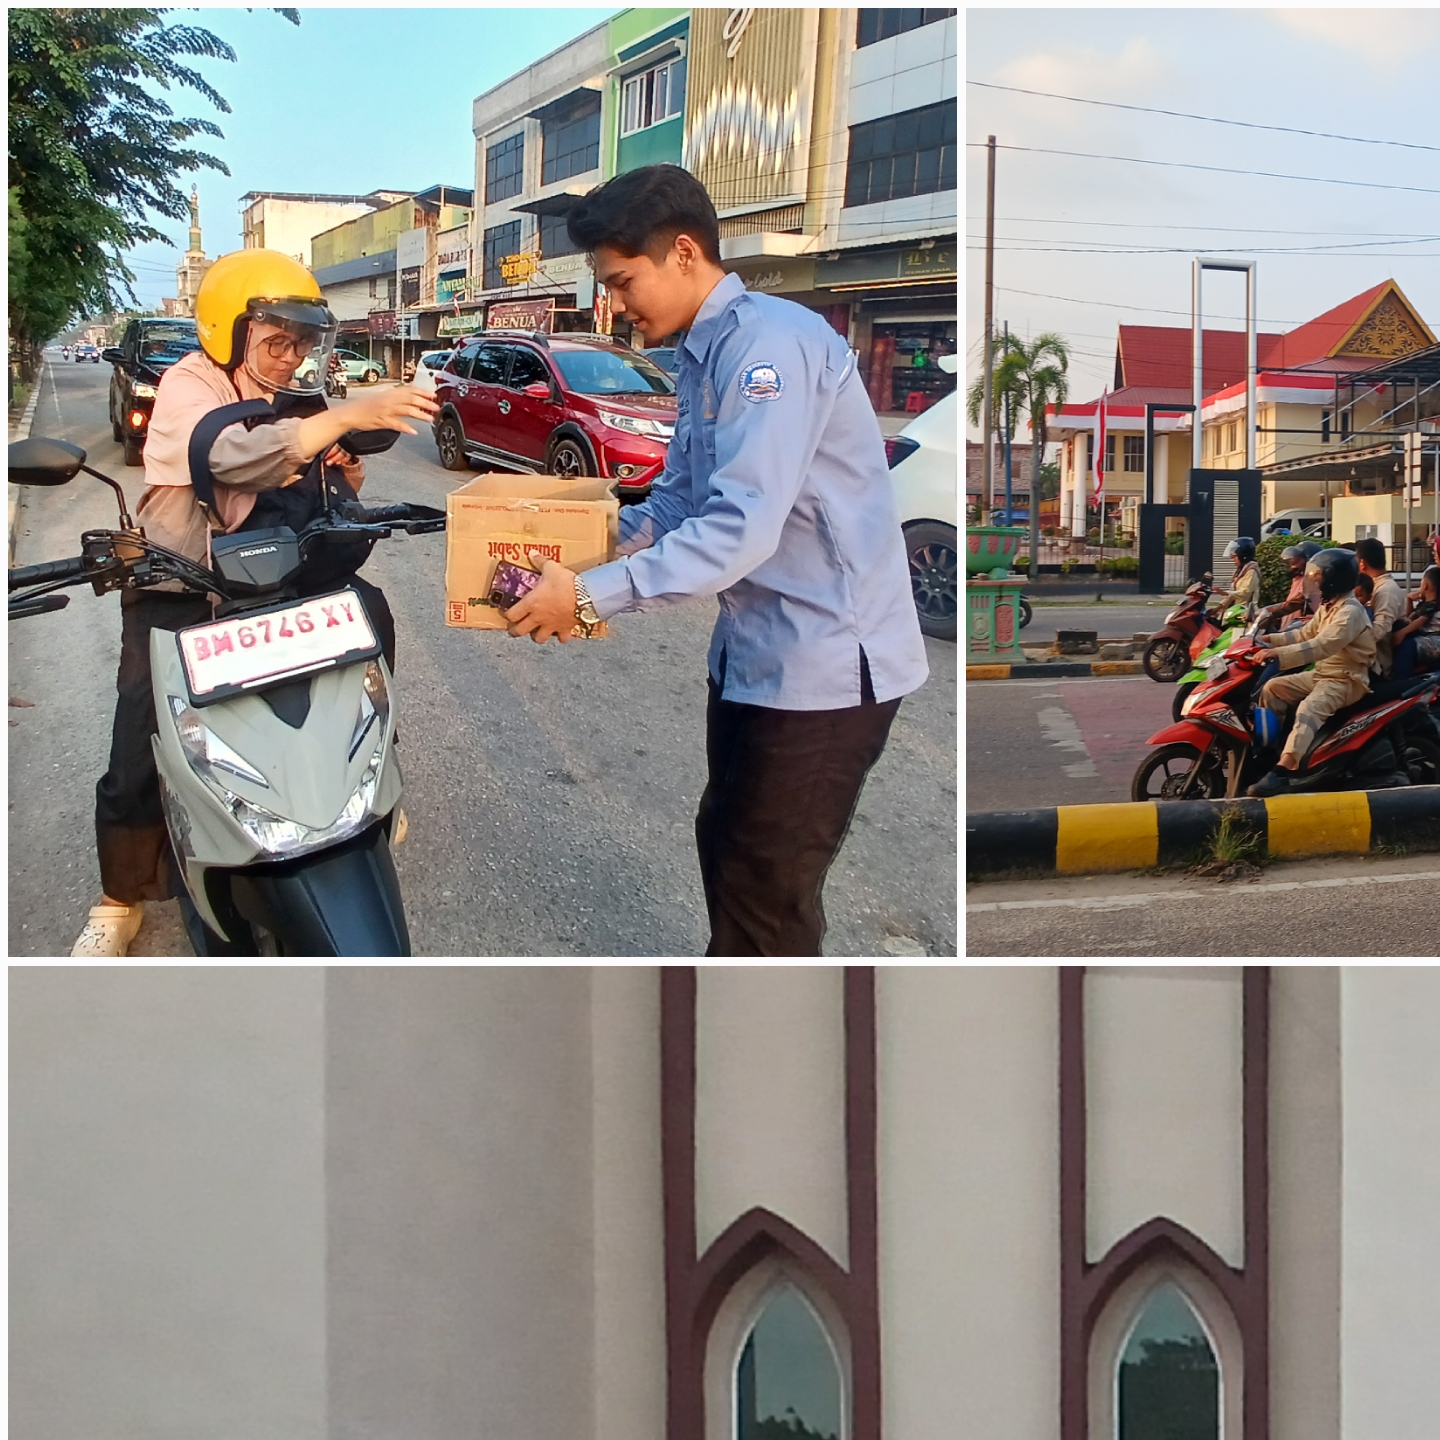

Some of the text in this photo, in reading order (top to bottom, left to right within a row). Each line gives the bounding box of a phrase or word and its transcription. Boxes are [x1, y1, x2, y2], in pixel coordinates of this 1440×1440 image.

[550, 260, 582, 274] BENUA
[754, 270, 784, 288] Gold
[493, 314, 538, 329] BENUA
[238, 546, 278, 558] HONDA
[488, 541, 520, 561] Sabit
[453, 610, 462, 619] 5
[193, 602, 355, 661] BM 6746 XY
